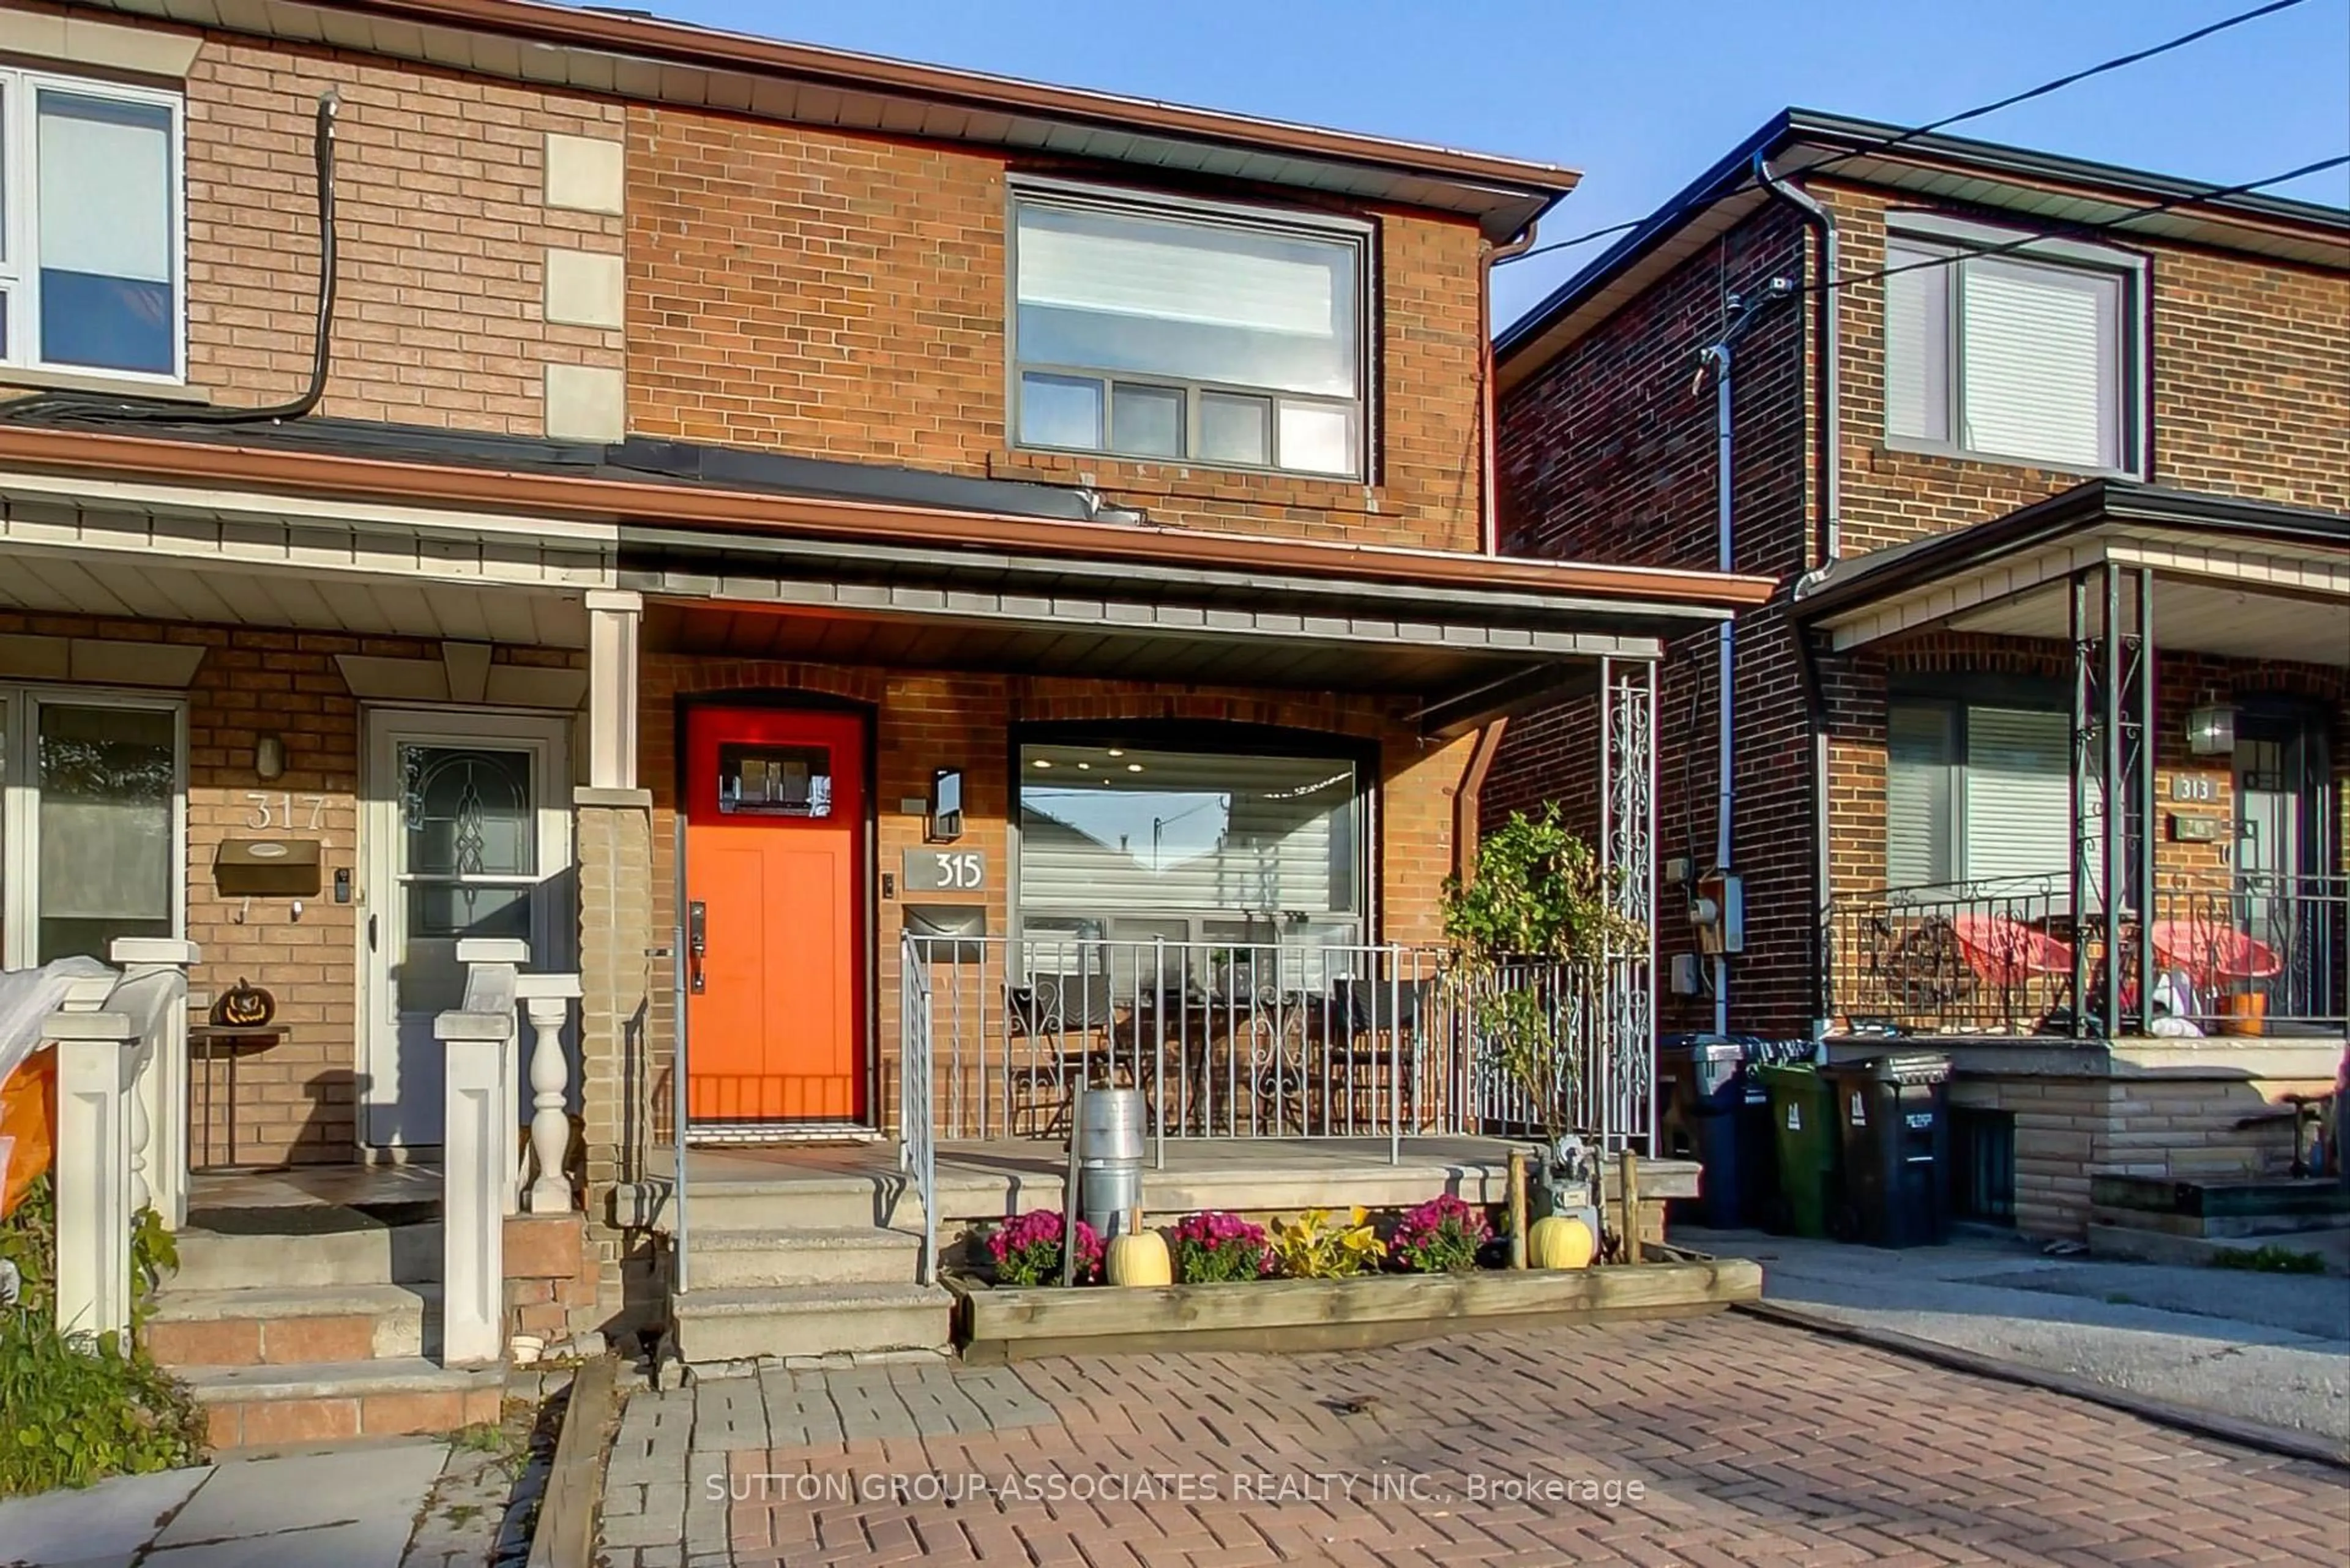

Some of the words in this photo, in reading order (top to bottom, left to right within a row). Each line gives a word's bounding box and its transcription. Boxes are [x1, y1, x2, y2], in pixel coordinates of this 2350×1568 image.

[2182, 779, 2208, 799] 313
[247, 793, 324, 830] 317
[936, 854, 982, 887] 315
